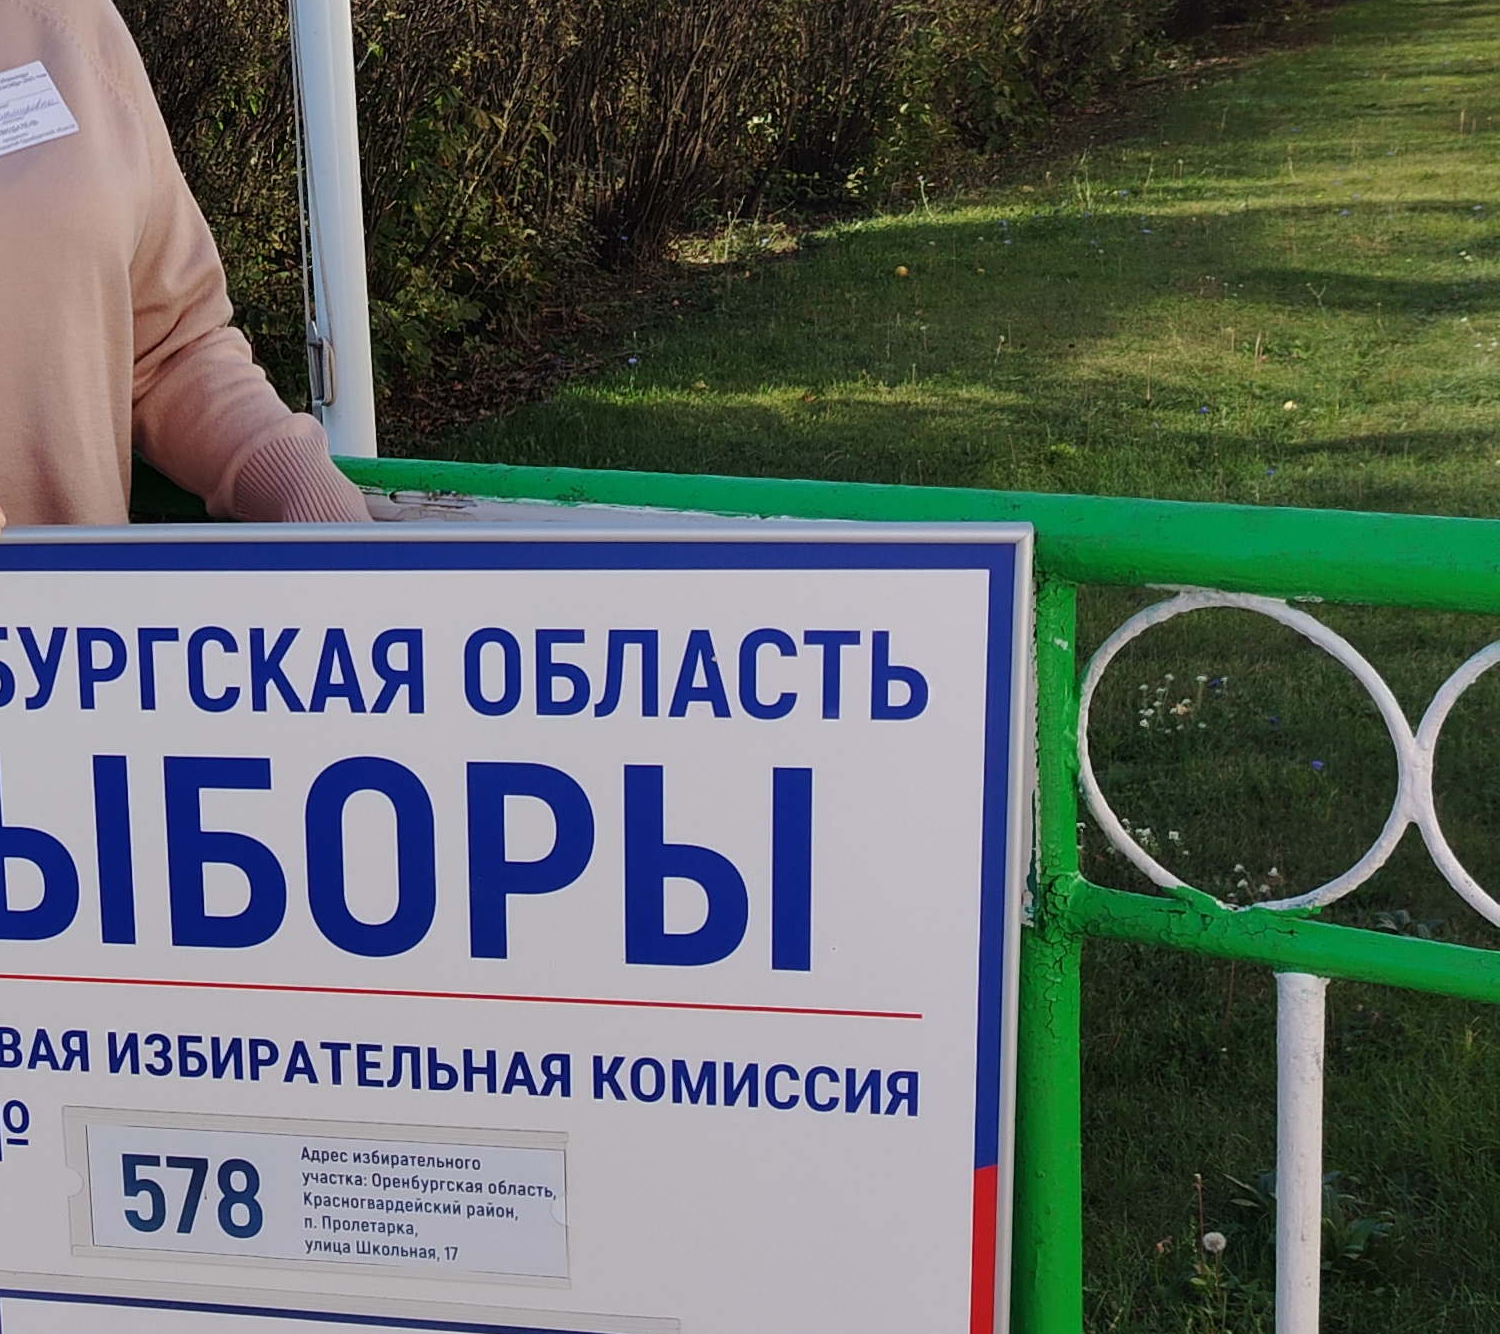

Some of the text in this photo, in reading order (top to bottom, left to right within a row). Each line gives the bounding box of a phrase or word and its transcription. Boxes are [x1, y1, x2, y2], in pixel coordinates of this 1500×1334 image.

[462, 625, 929, 720] ОБЛАСТЬ
[107, 1031, 573, 1100] ИЗБИРАТЕЛЬНАЯ
[591, 1056, 920, 1117] КОМИССИЯ
[300, 1146, 481, 1172] Адрес избирательного
[121, 1153, 263, 1239] 578
[302, 1170, 557, 1200] участка: Оренбургская область,
[303, 1192, 519, 1221] Красногвардейский район,
[304, 1215, 419, 1237] п. Пролетарка,
[305, 1238, 458, 1262] улица Школьная, 17
